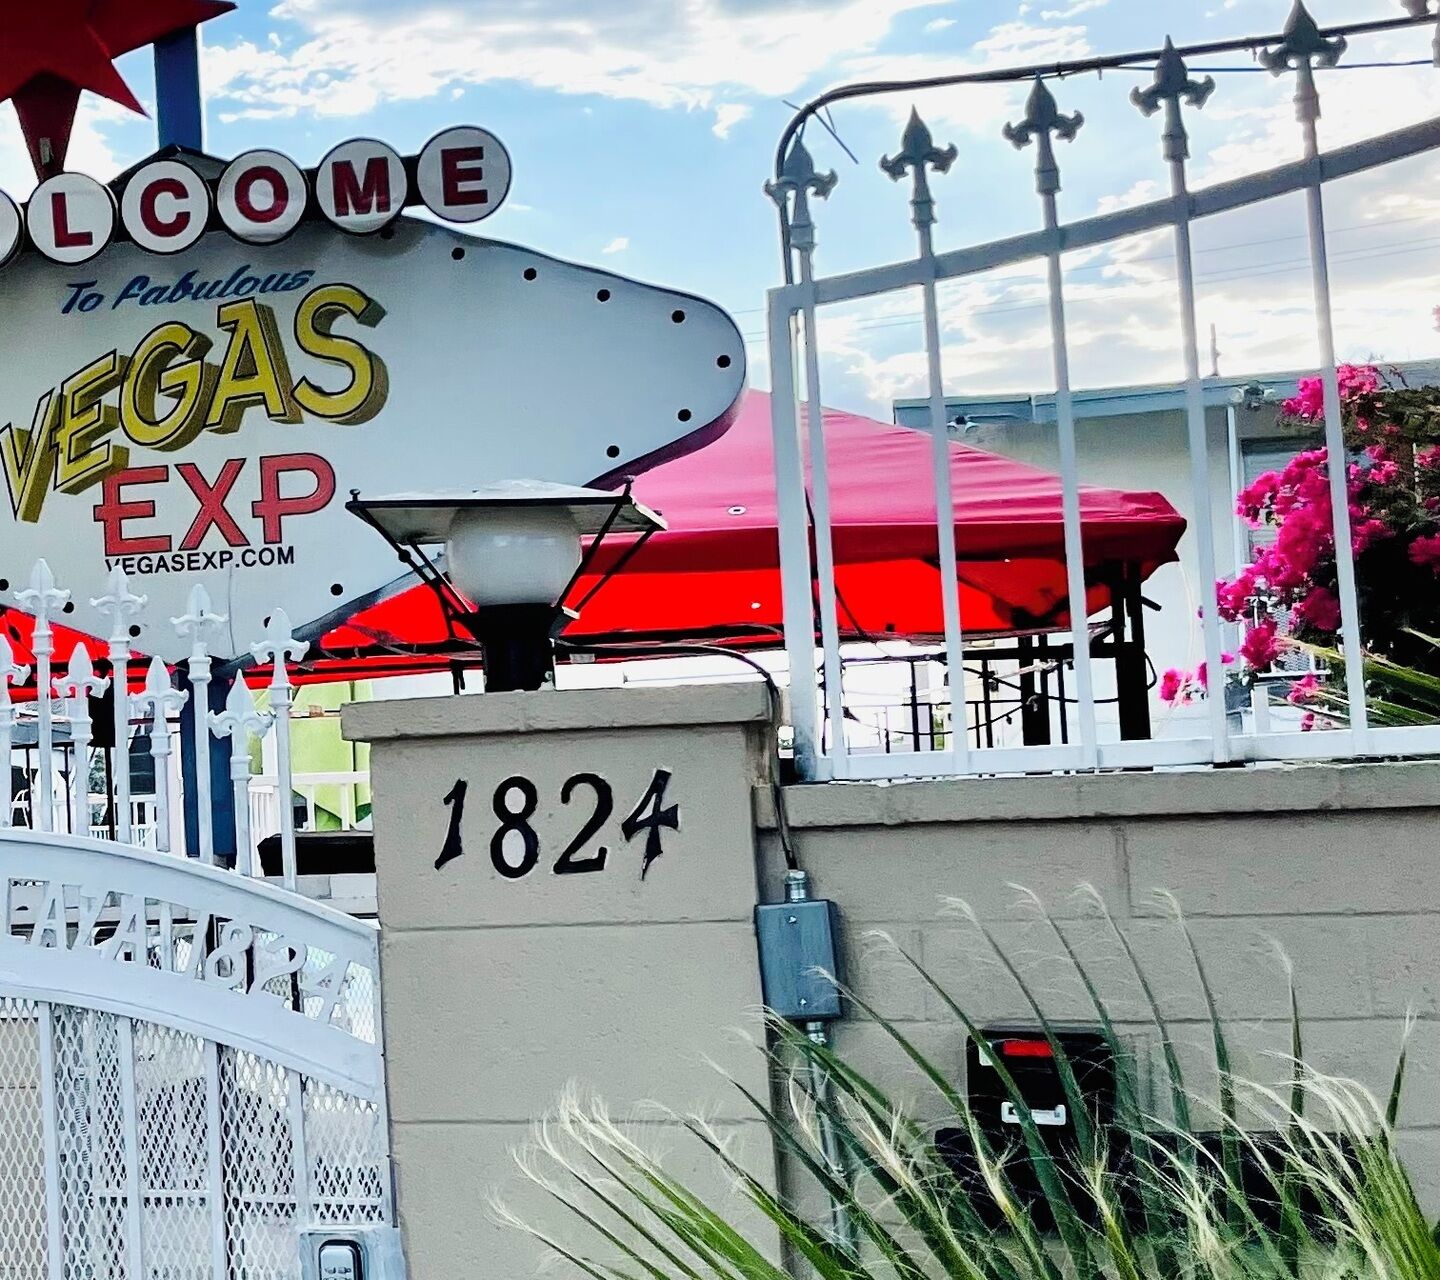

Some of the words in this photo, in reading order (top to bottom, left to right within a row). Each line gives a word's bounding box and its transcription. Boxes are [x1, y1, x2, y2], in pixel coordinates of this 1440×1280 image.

[61, 280, 105, 314] To
[93, 452, 336, 556] EXP
[434, 768, 679, 880] 1824
[190, 910, 351, 1025] 1824
